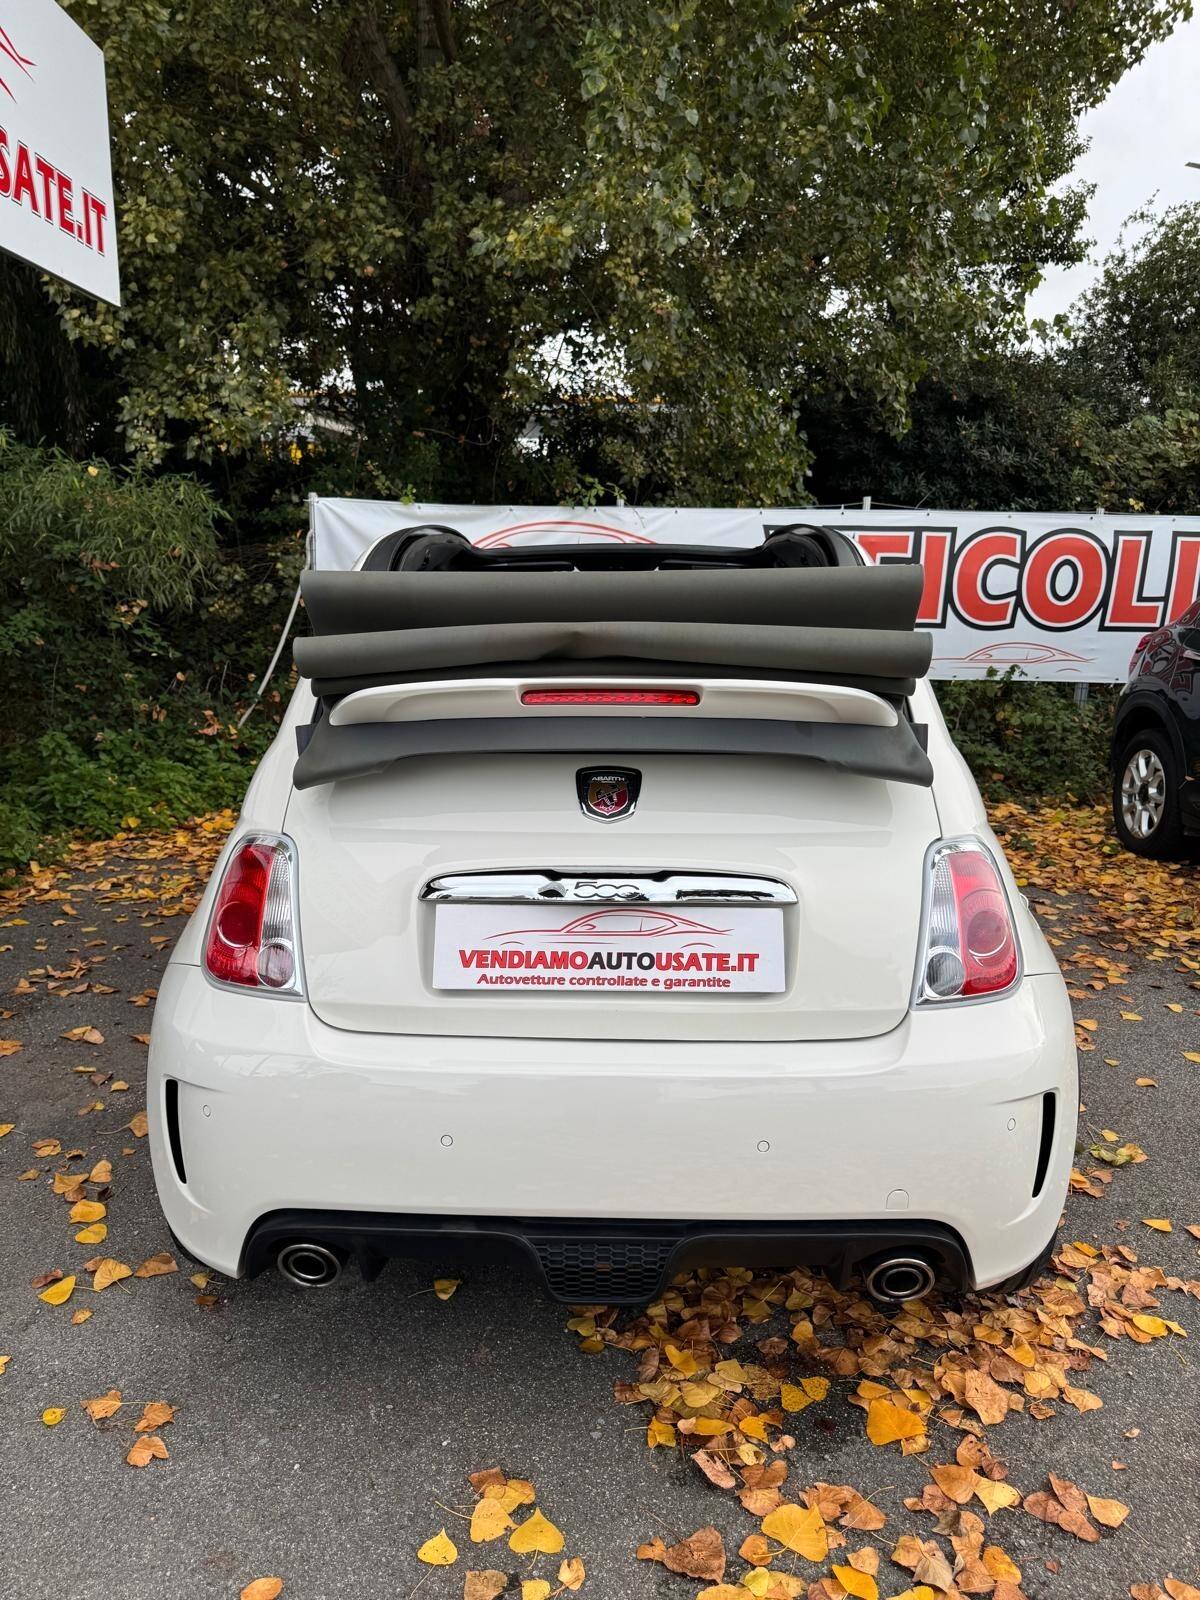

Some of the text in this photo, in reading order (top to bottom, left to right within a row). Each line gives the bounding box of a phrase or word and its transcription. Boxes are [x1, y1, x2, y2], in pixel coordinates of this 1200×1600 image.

[573, 881, 640, 899] 500
[459, 949, 760, 972] VENDIAMOAUTOUSATE.IT
[477, 973, 731, 990] Autovetture controllate e garantite
